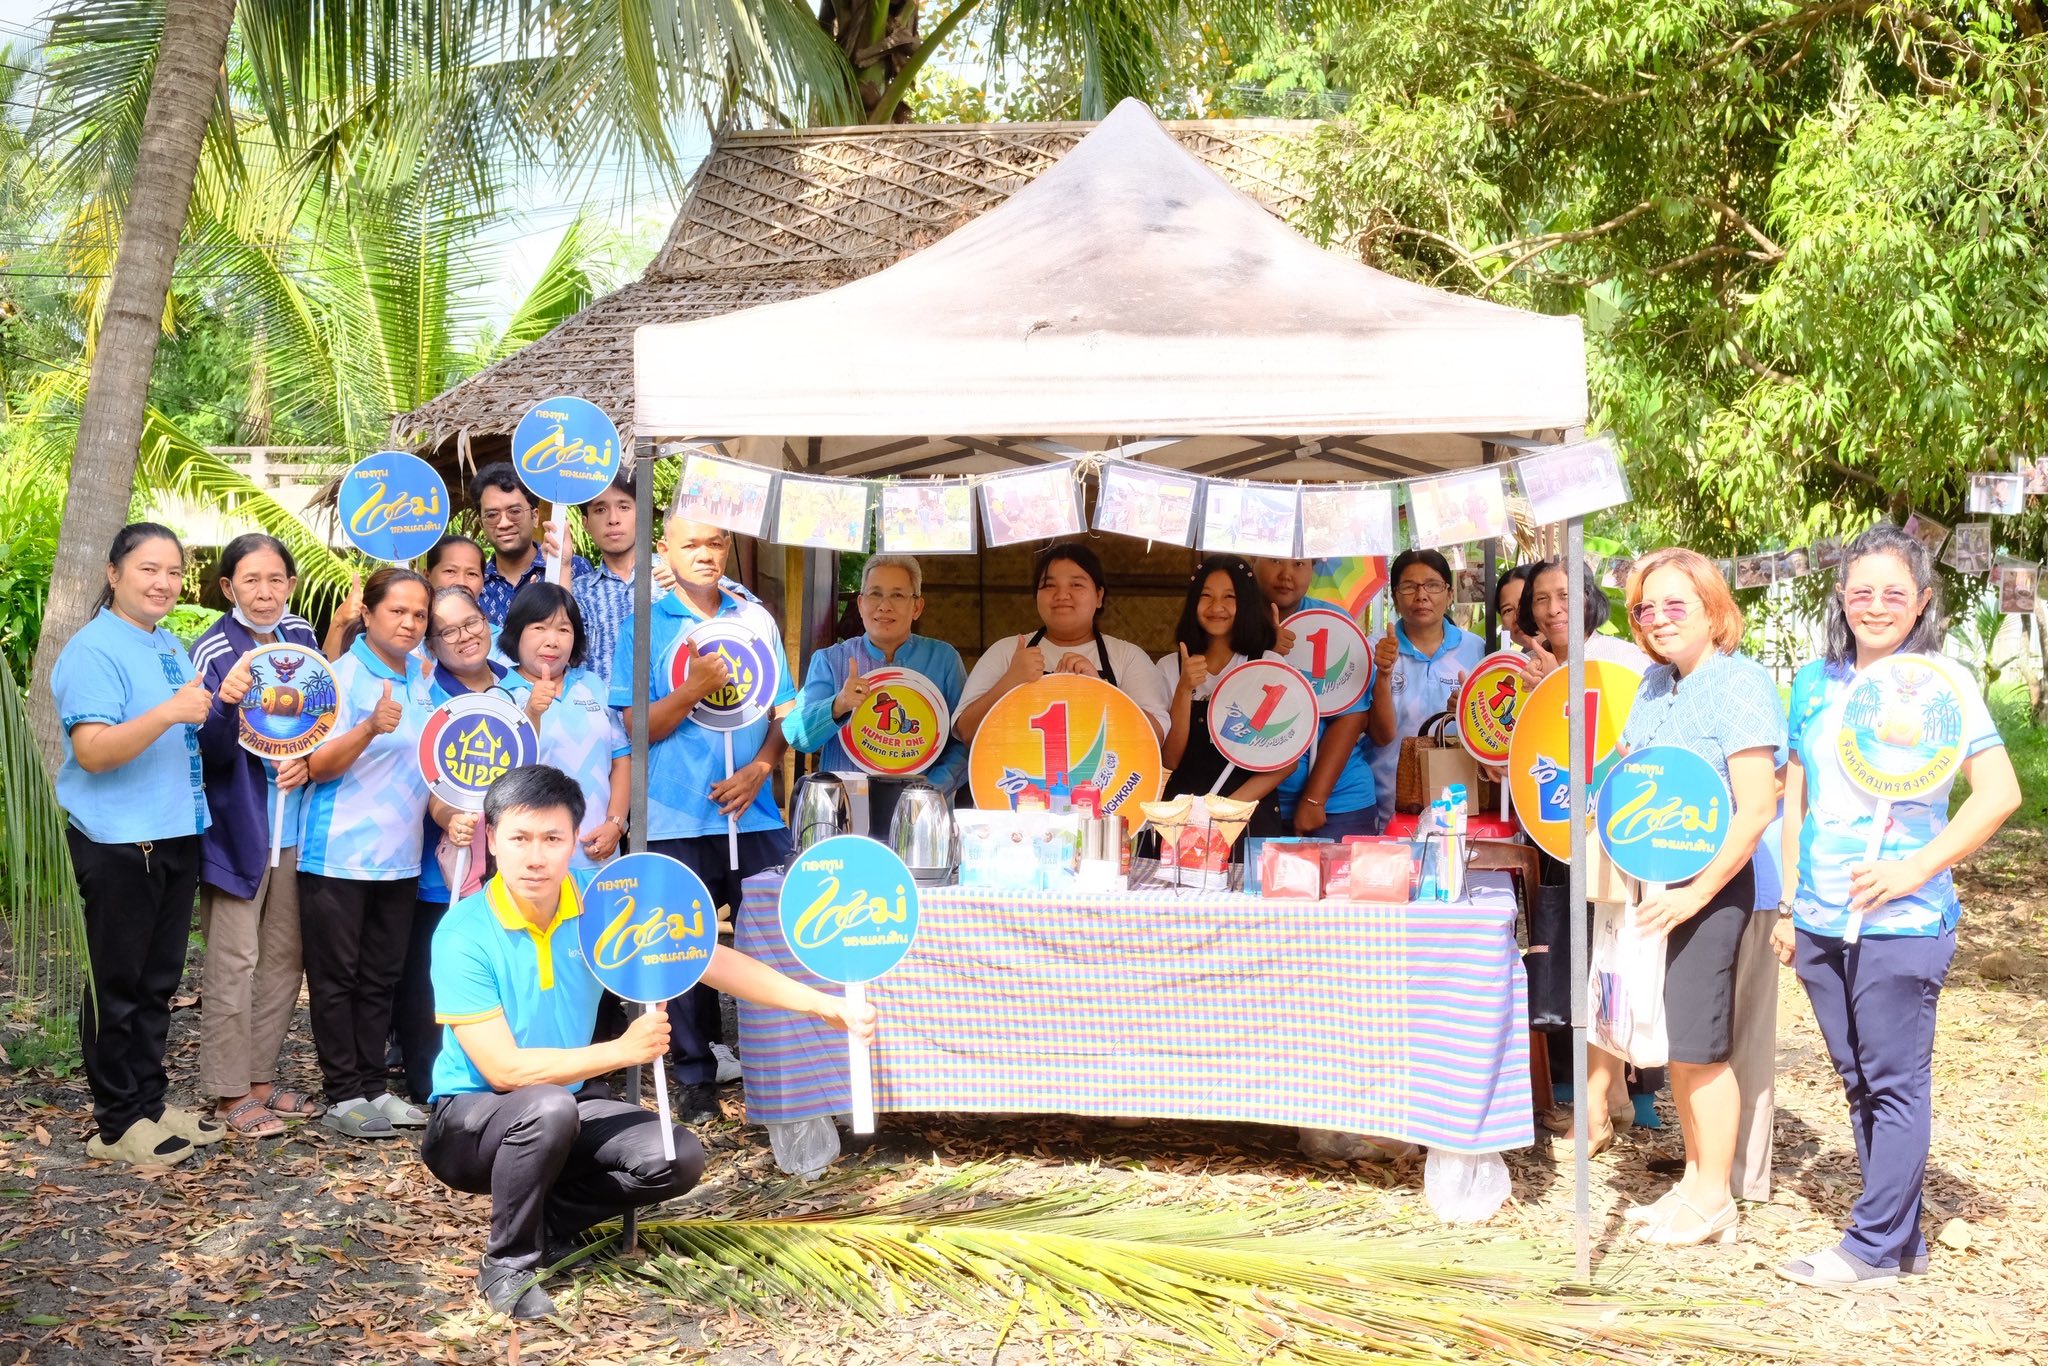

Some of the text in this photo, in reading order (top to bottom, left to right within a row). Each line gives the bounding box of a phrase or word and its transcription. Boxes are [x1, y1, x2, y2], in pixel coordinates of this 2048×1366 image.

[535, 409, 569, 423] กองทุน
[354, 469, 389, 480] กองทุน
[559, 466, 609, 482] ของแผ่นดิน
[390, 518, 441, 534] ของแผ่นดิน
[1306, 628, 1328, 679] 1
[1261, 684, 1288, 732] 1
[1477, 691, 1510, 745] NUMBER ONE
[861, 725, 925, 747] NUMBER ONE
[1229, 722, 1251, 738] BE
[1031, 702, 1068, 787] 1
[1623, 763, 1665, 779] กองทุน
[1843, 739, 1951, 793] จังหวัดสมุทรสงคราม
[1102, 772, 1142, 816] NGHKRAM
[1651, 833, 1715, 853] ของแผ่นดิน
[801, 859, 844, 875] กองทุน
[596, 877, 639, 893] กองทุน
[842, 927, 909, 947] ของแผ่นดิน
[642, 943, 709, 965] ของแผ่นดิน
